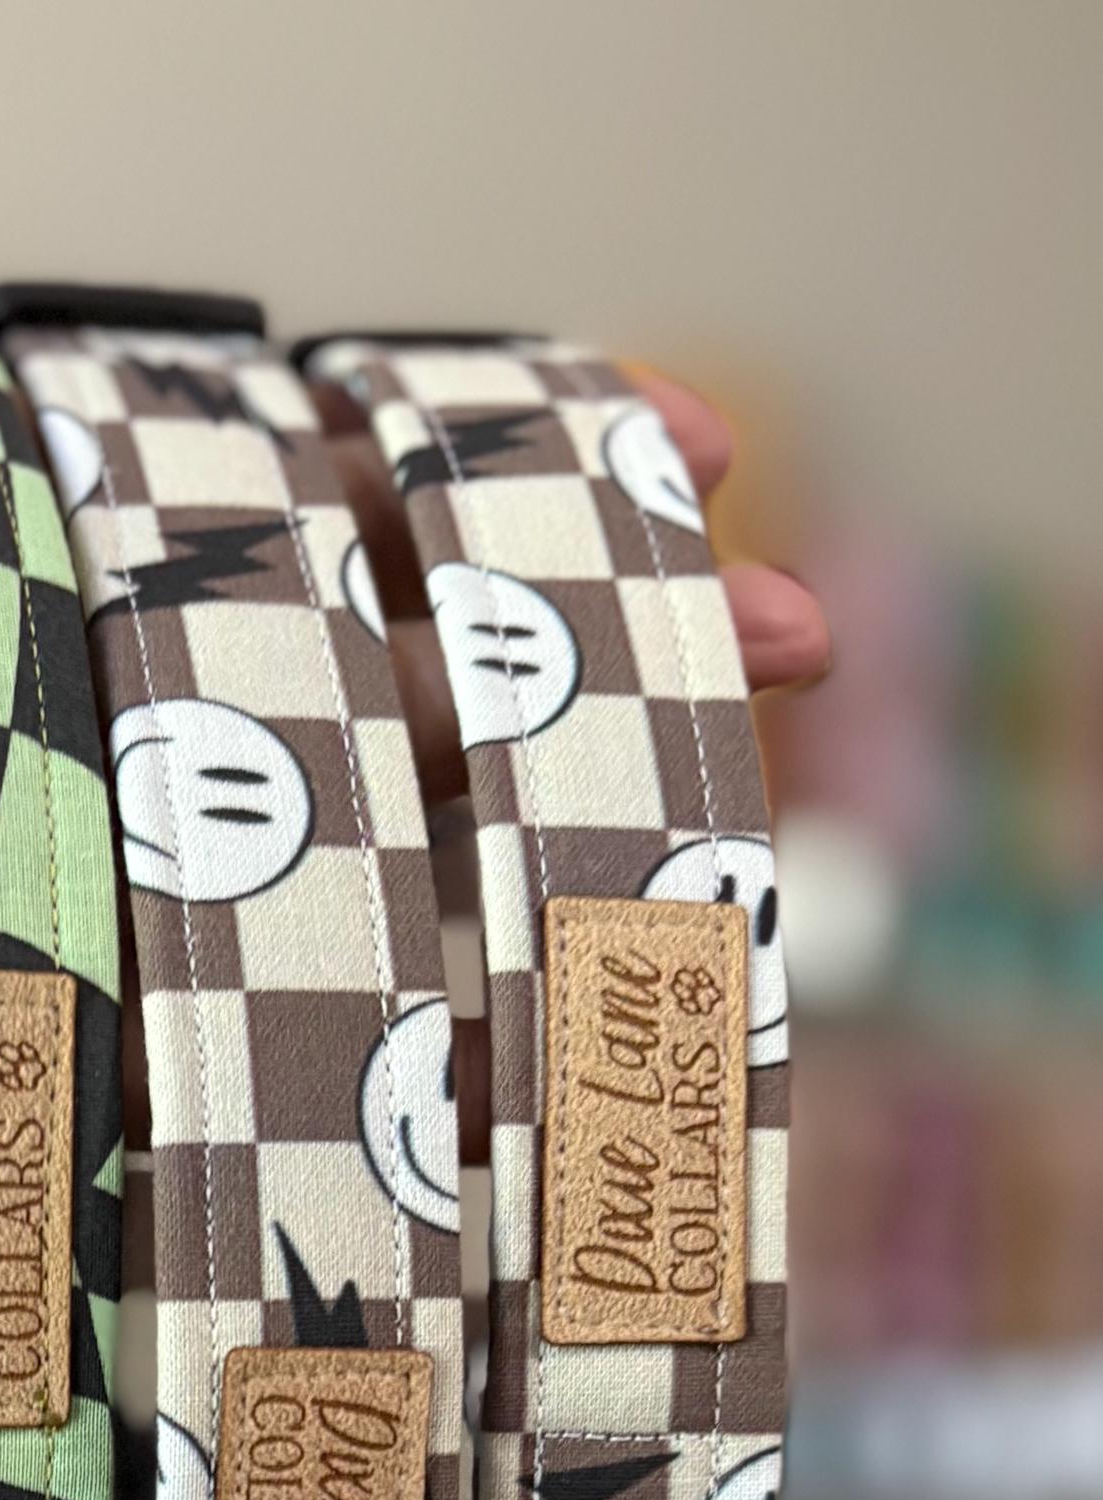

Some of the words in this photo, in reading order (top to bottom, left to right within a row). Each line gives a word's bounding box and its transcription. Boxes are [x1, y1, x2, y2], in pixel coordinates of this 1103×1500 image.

[578, 950, 666, 1107] Lane
[568, 1136, 668, 1296] Dixie
[670, 1042, 722, 1297] COLLARS
